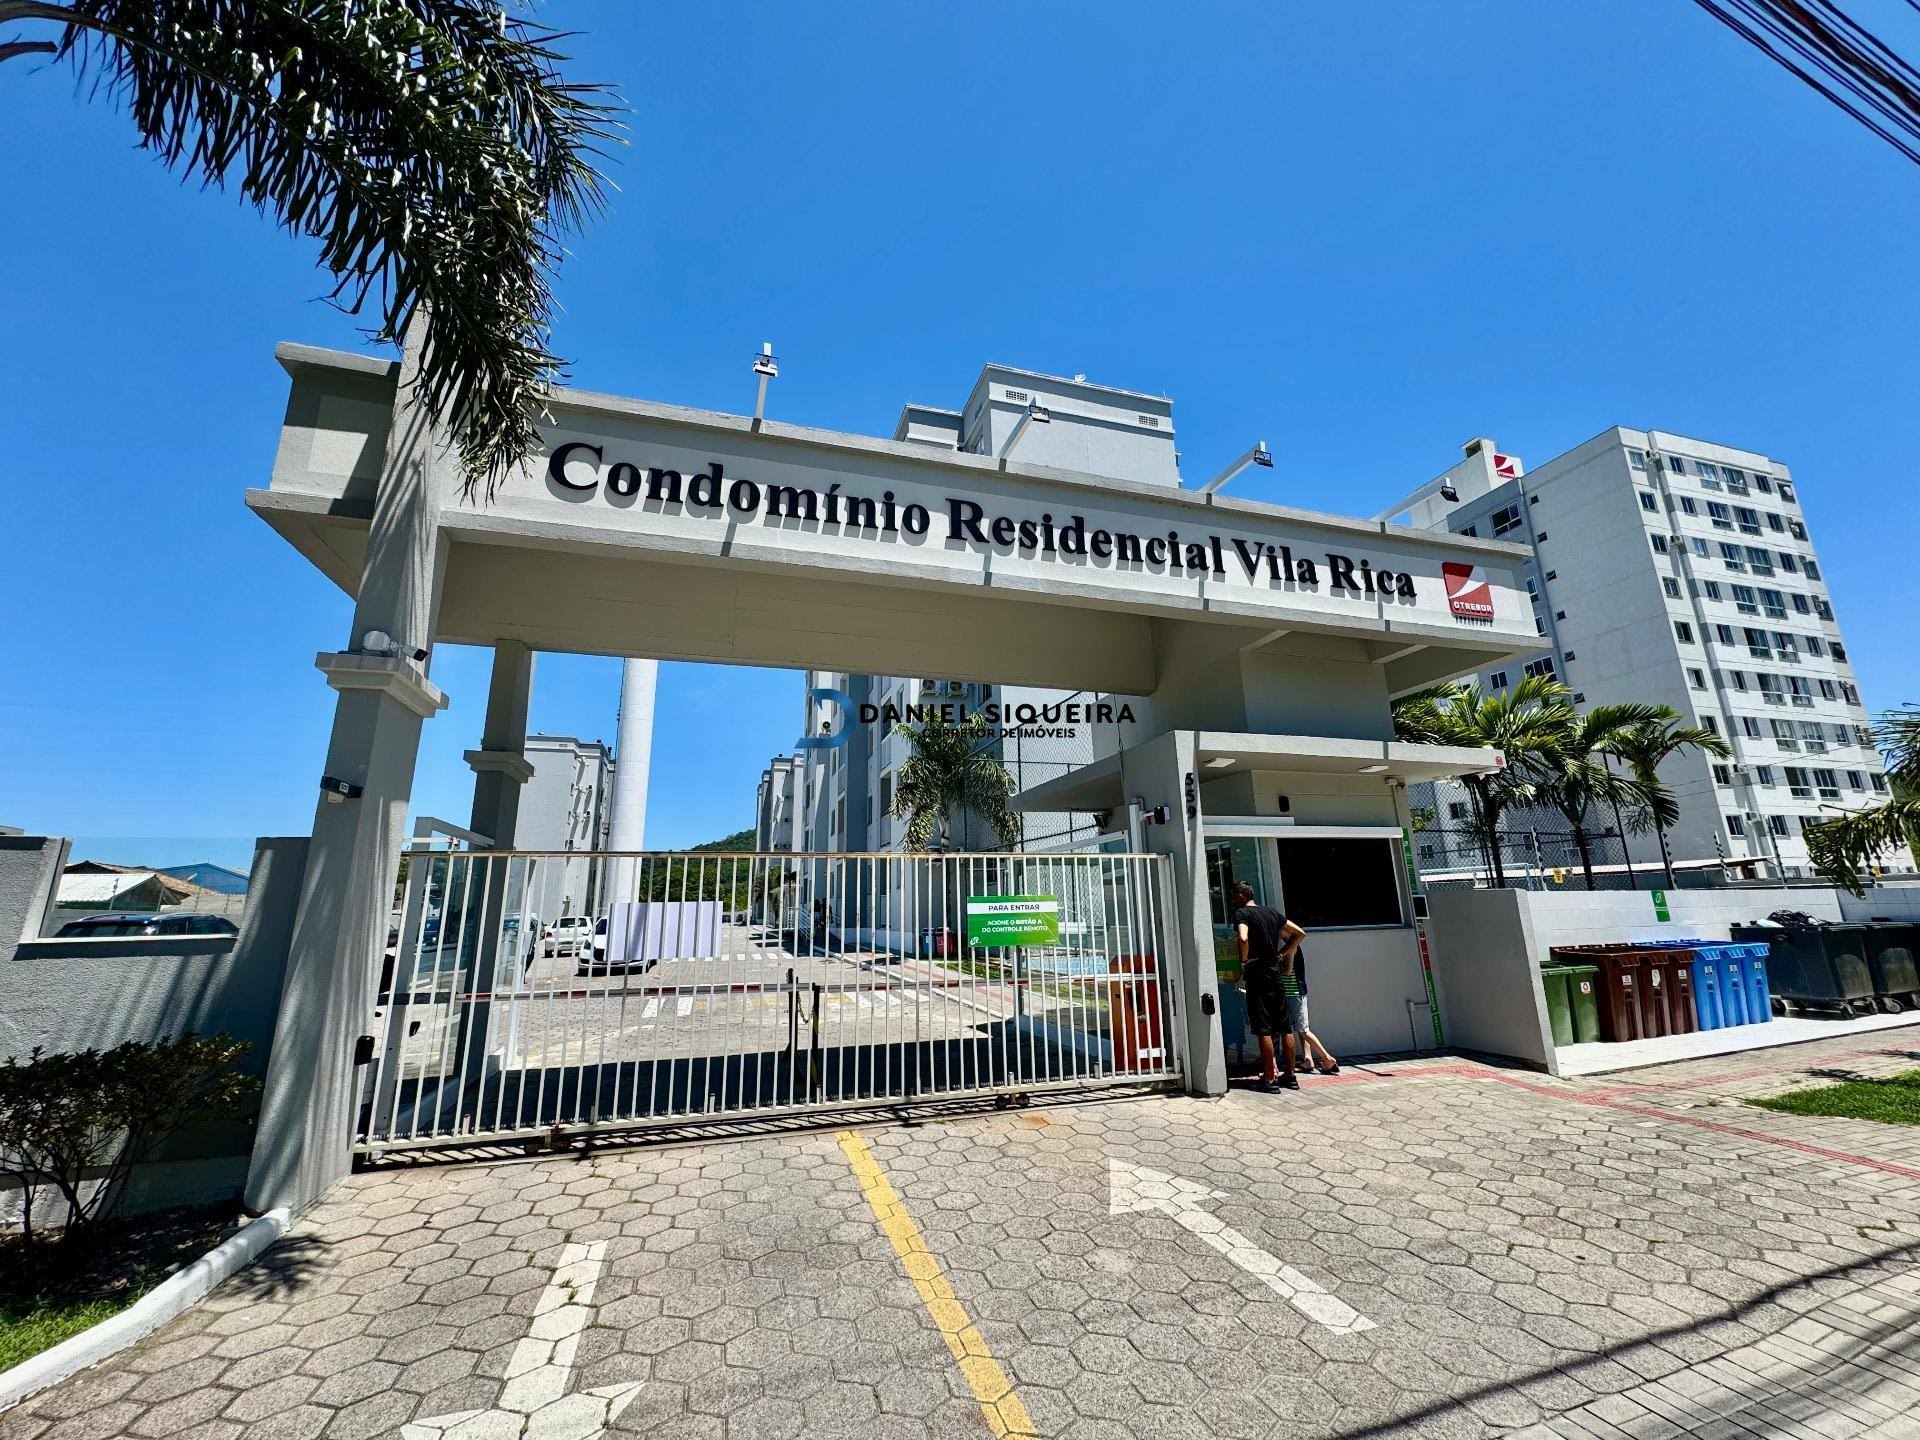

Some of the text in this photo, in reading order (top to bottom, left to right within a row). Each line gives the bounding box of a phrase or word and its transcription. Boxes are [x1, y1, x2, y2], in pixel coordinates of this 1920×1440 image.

[549, 442, 1418, 599] Condomínio Residencial Vila Rica
[1453, 601, 1493, 612] OTREBOR
